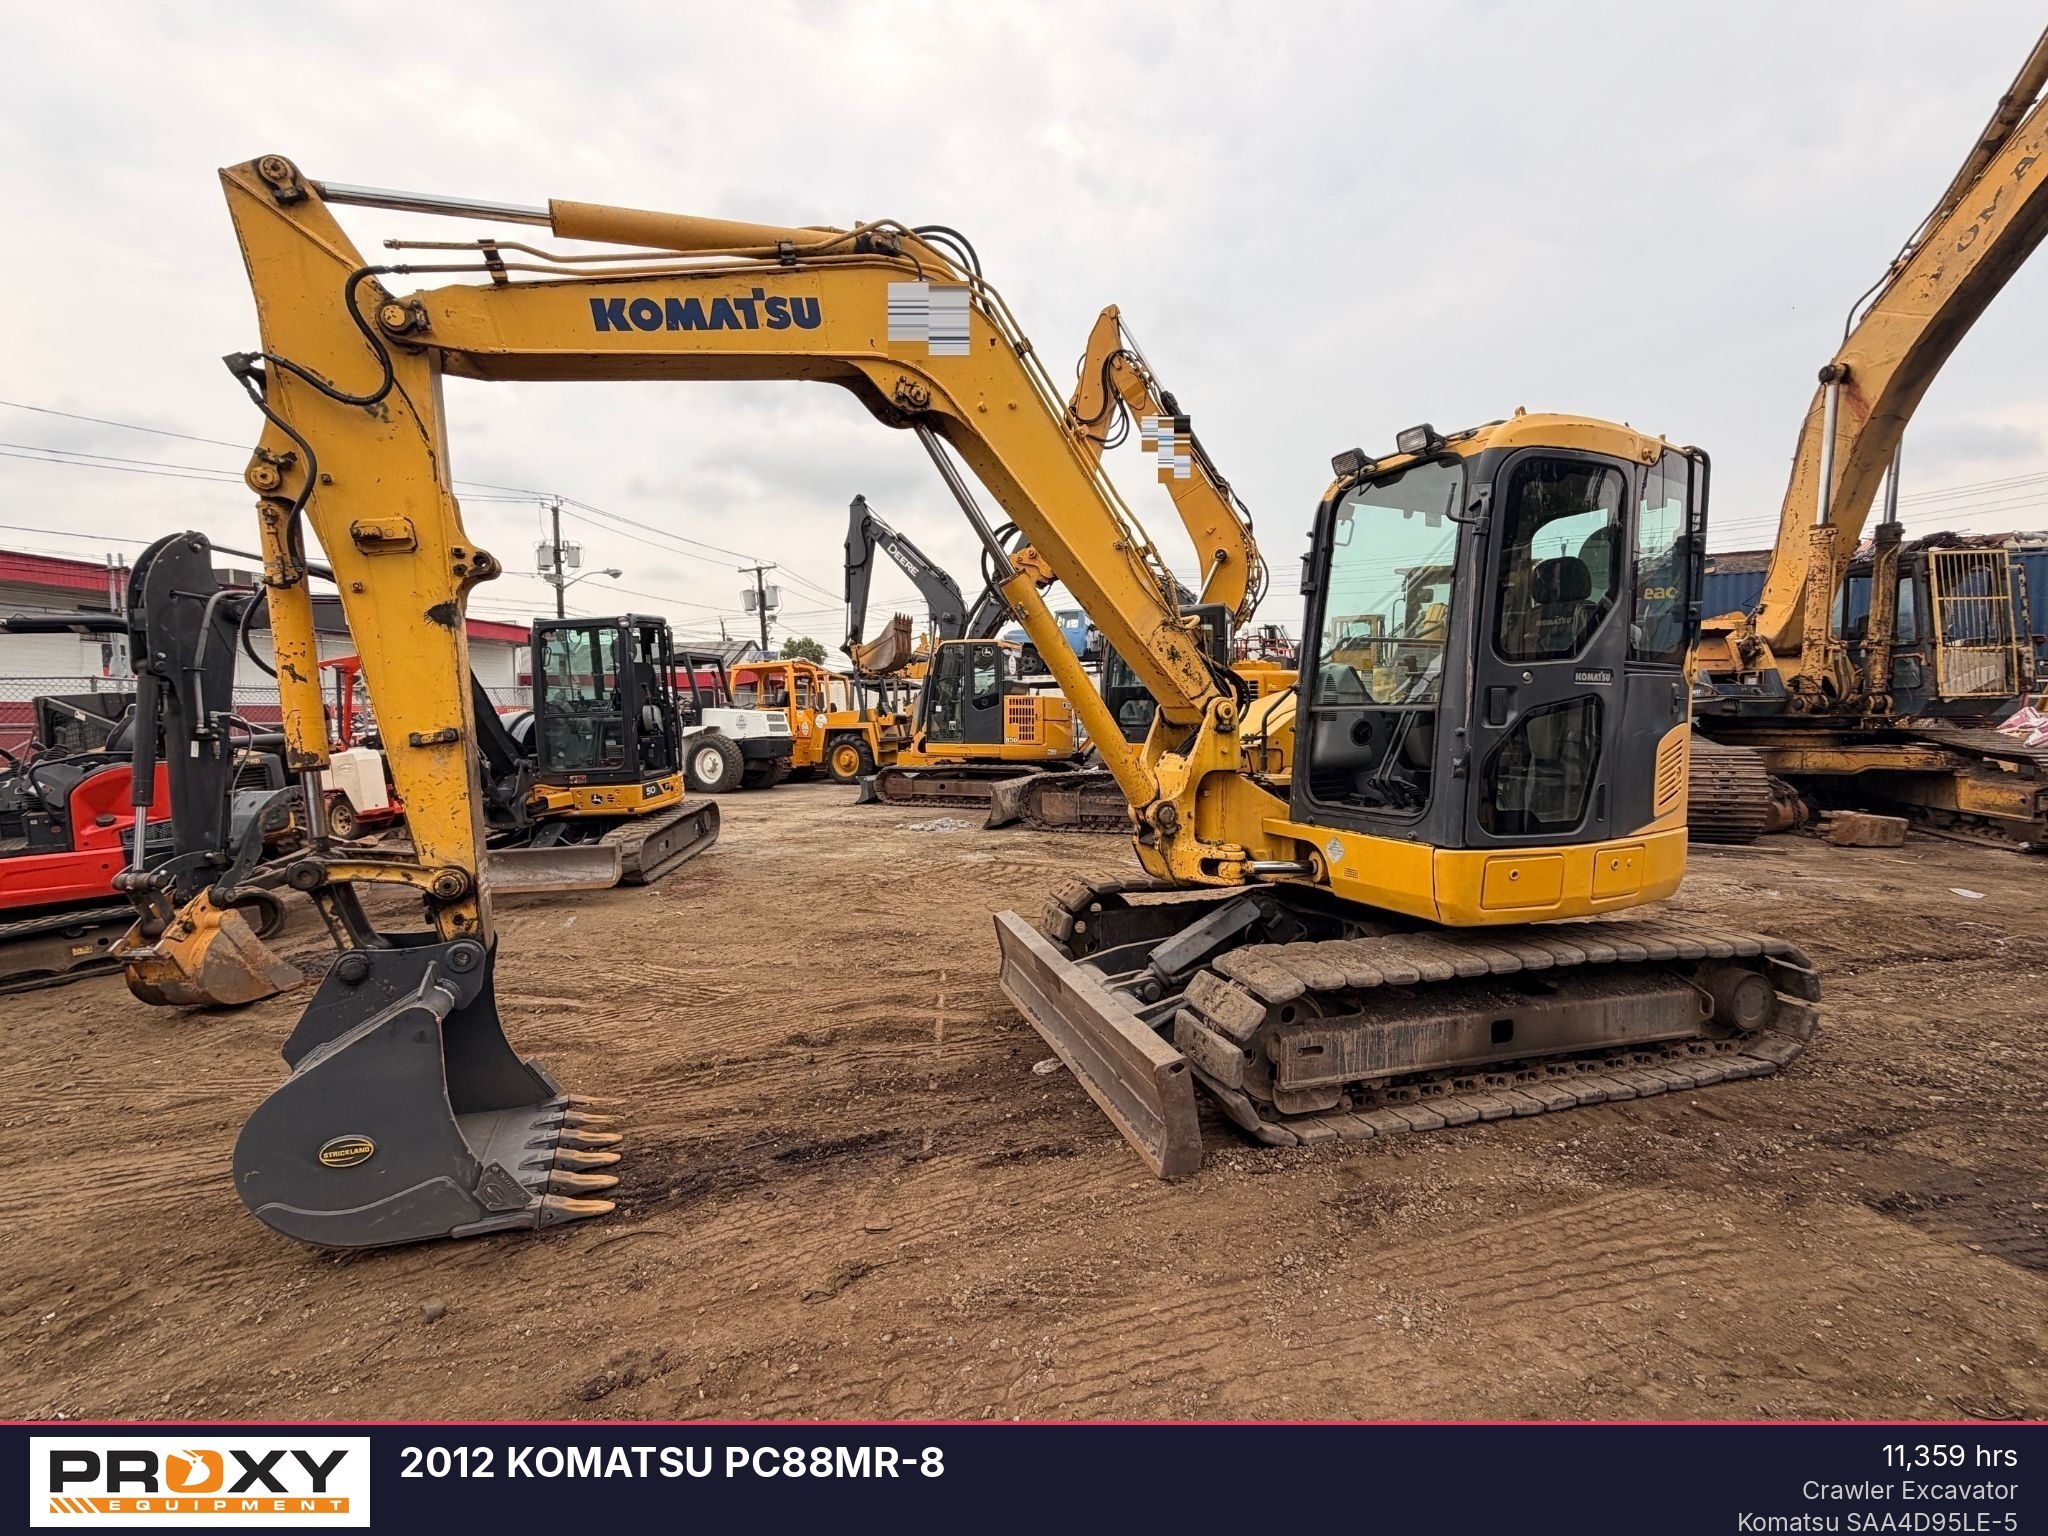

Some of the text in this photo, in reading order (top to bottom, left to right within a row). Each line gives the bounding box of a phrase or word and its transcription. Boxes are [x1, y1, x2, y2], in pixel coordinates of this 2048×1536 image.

[591, 288, 821, 330] KOMATSU
[887, 543, 919, 577] DEERE
[1536, 616, 1572, 627] KOMATSU
[1575, 671, 1611, 682] KOMATSU
[645, 785, 656, 796] 50
[322, 1146, 370, 1159] STRICKLAND
